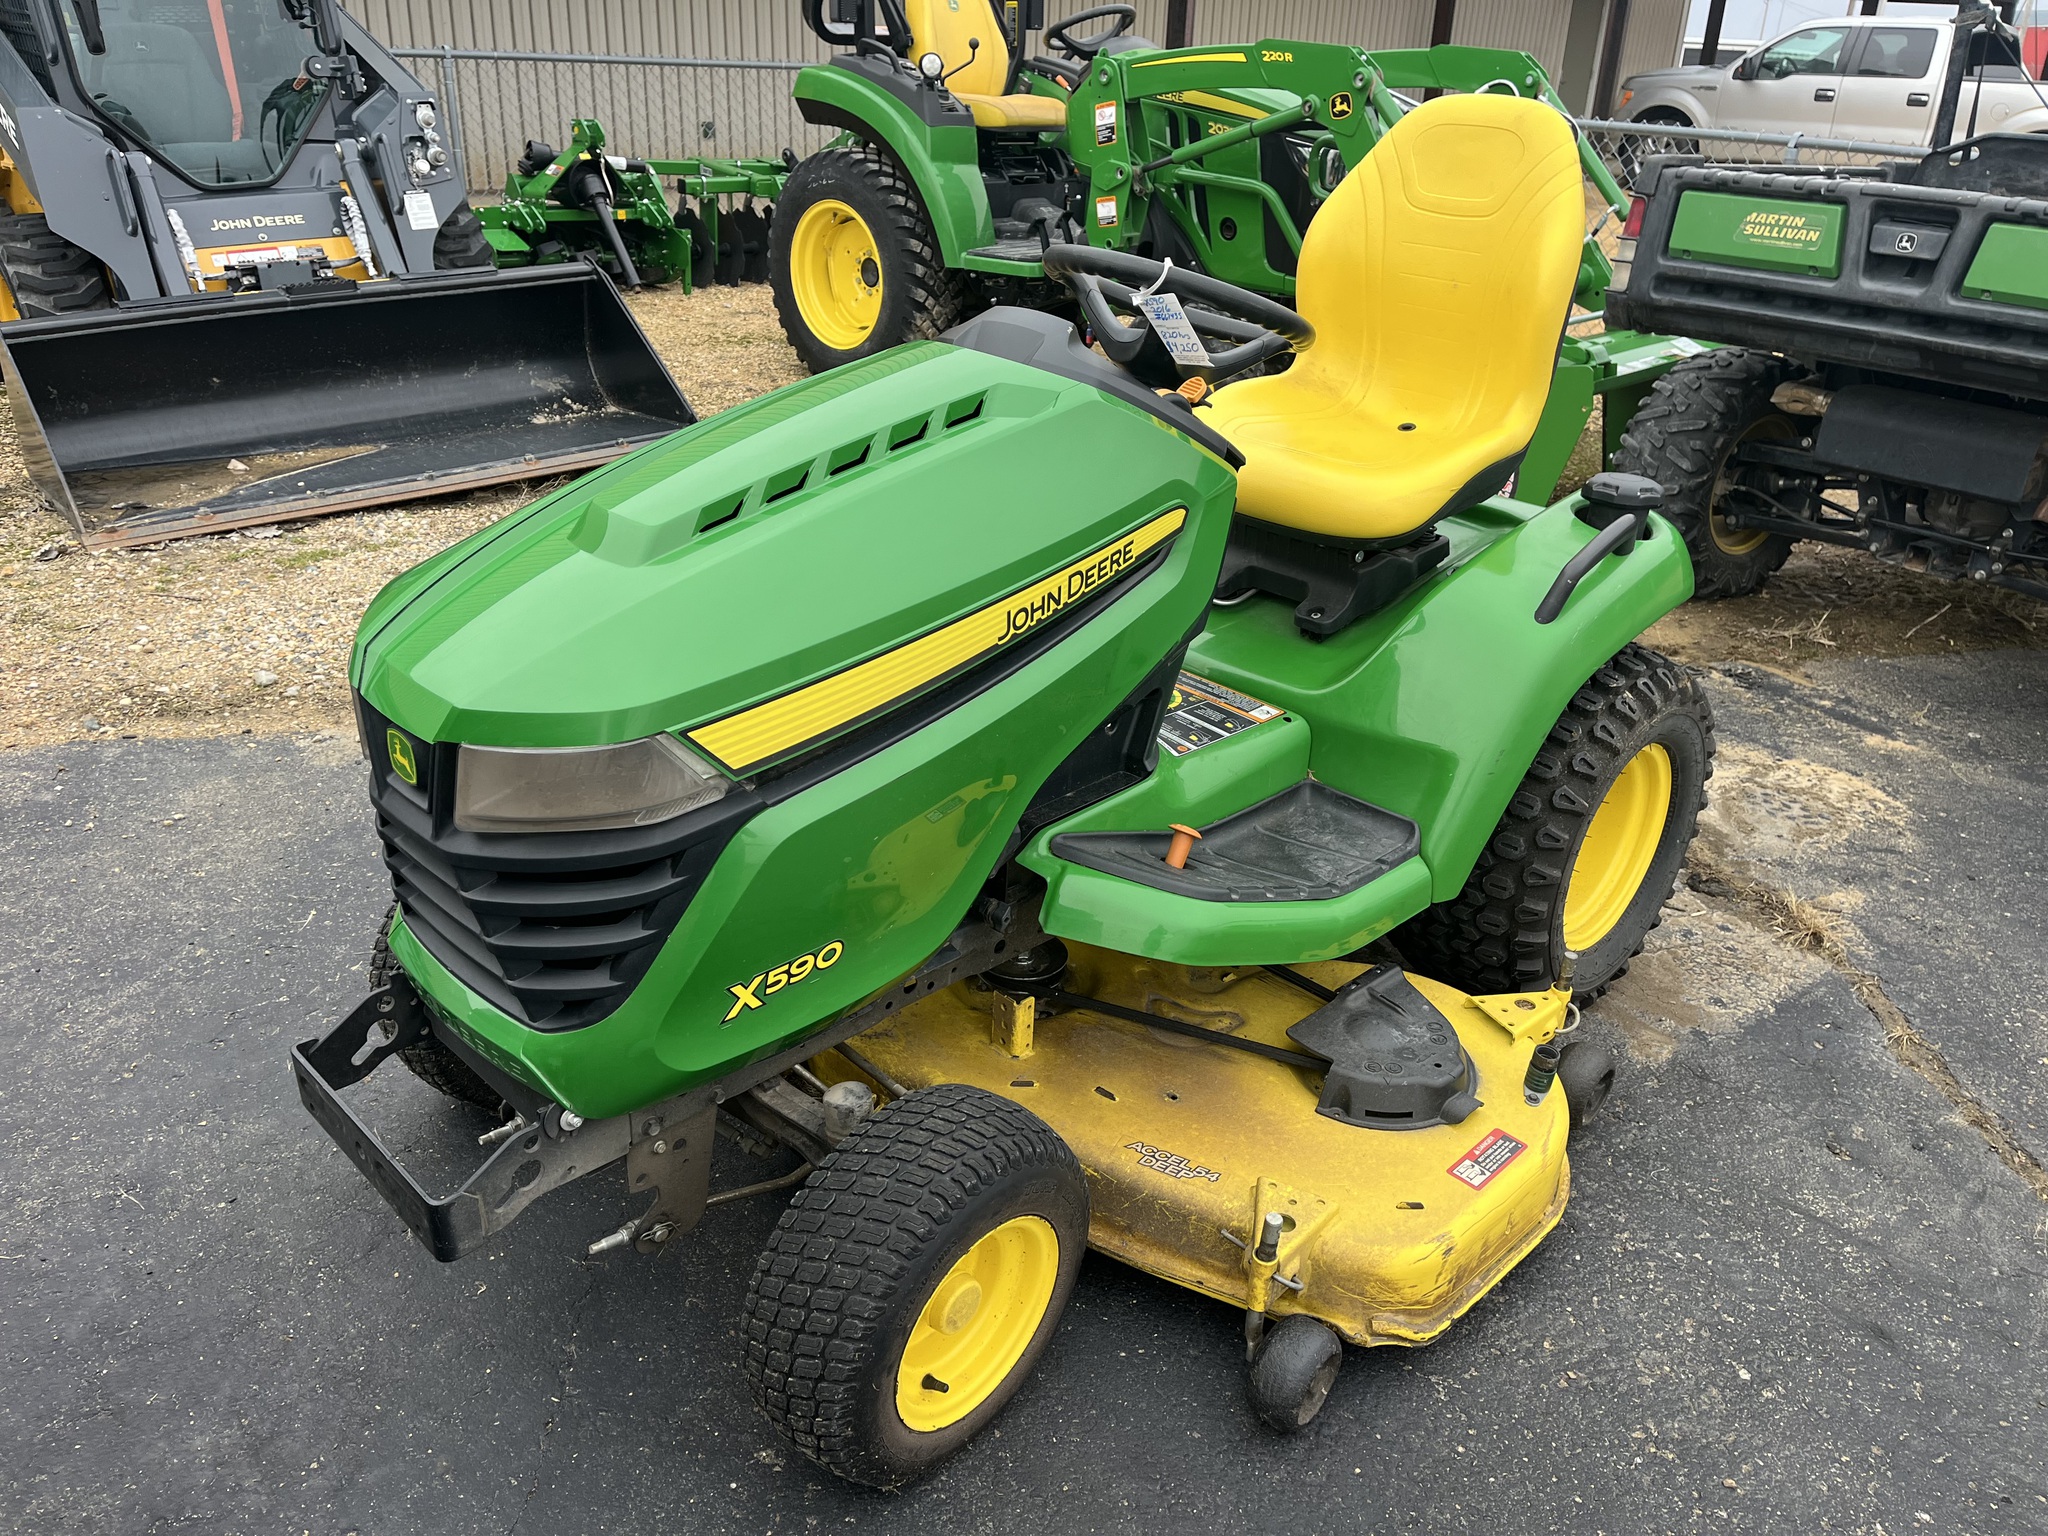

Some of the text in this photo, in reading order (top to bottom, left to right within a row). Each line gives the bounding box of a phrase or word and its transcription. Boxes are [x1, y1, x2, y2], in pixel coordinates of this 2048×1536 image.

[1261, 51, 1293, 62] 220R
[210, 214, 306, 231] JOHN DEERE
[1744, 212, 1806, 227] MARTIN
[1743, 223, 1820, 242] SULLIVAN
[1144, 296, 1165, 307] X590
[1151, 304, 1171, 313] 2016
[998, 539, 1136, 644] JOHN DEERE
[720, 939, 845, 1025] X590
[1123, 1141, 1222, 1183] ACCEL 54
[1137, 1155, 1195, 1179] DEEP
